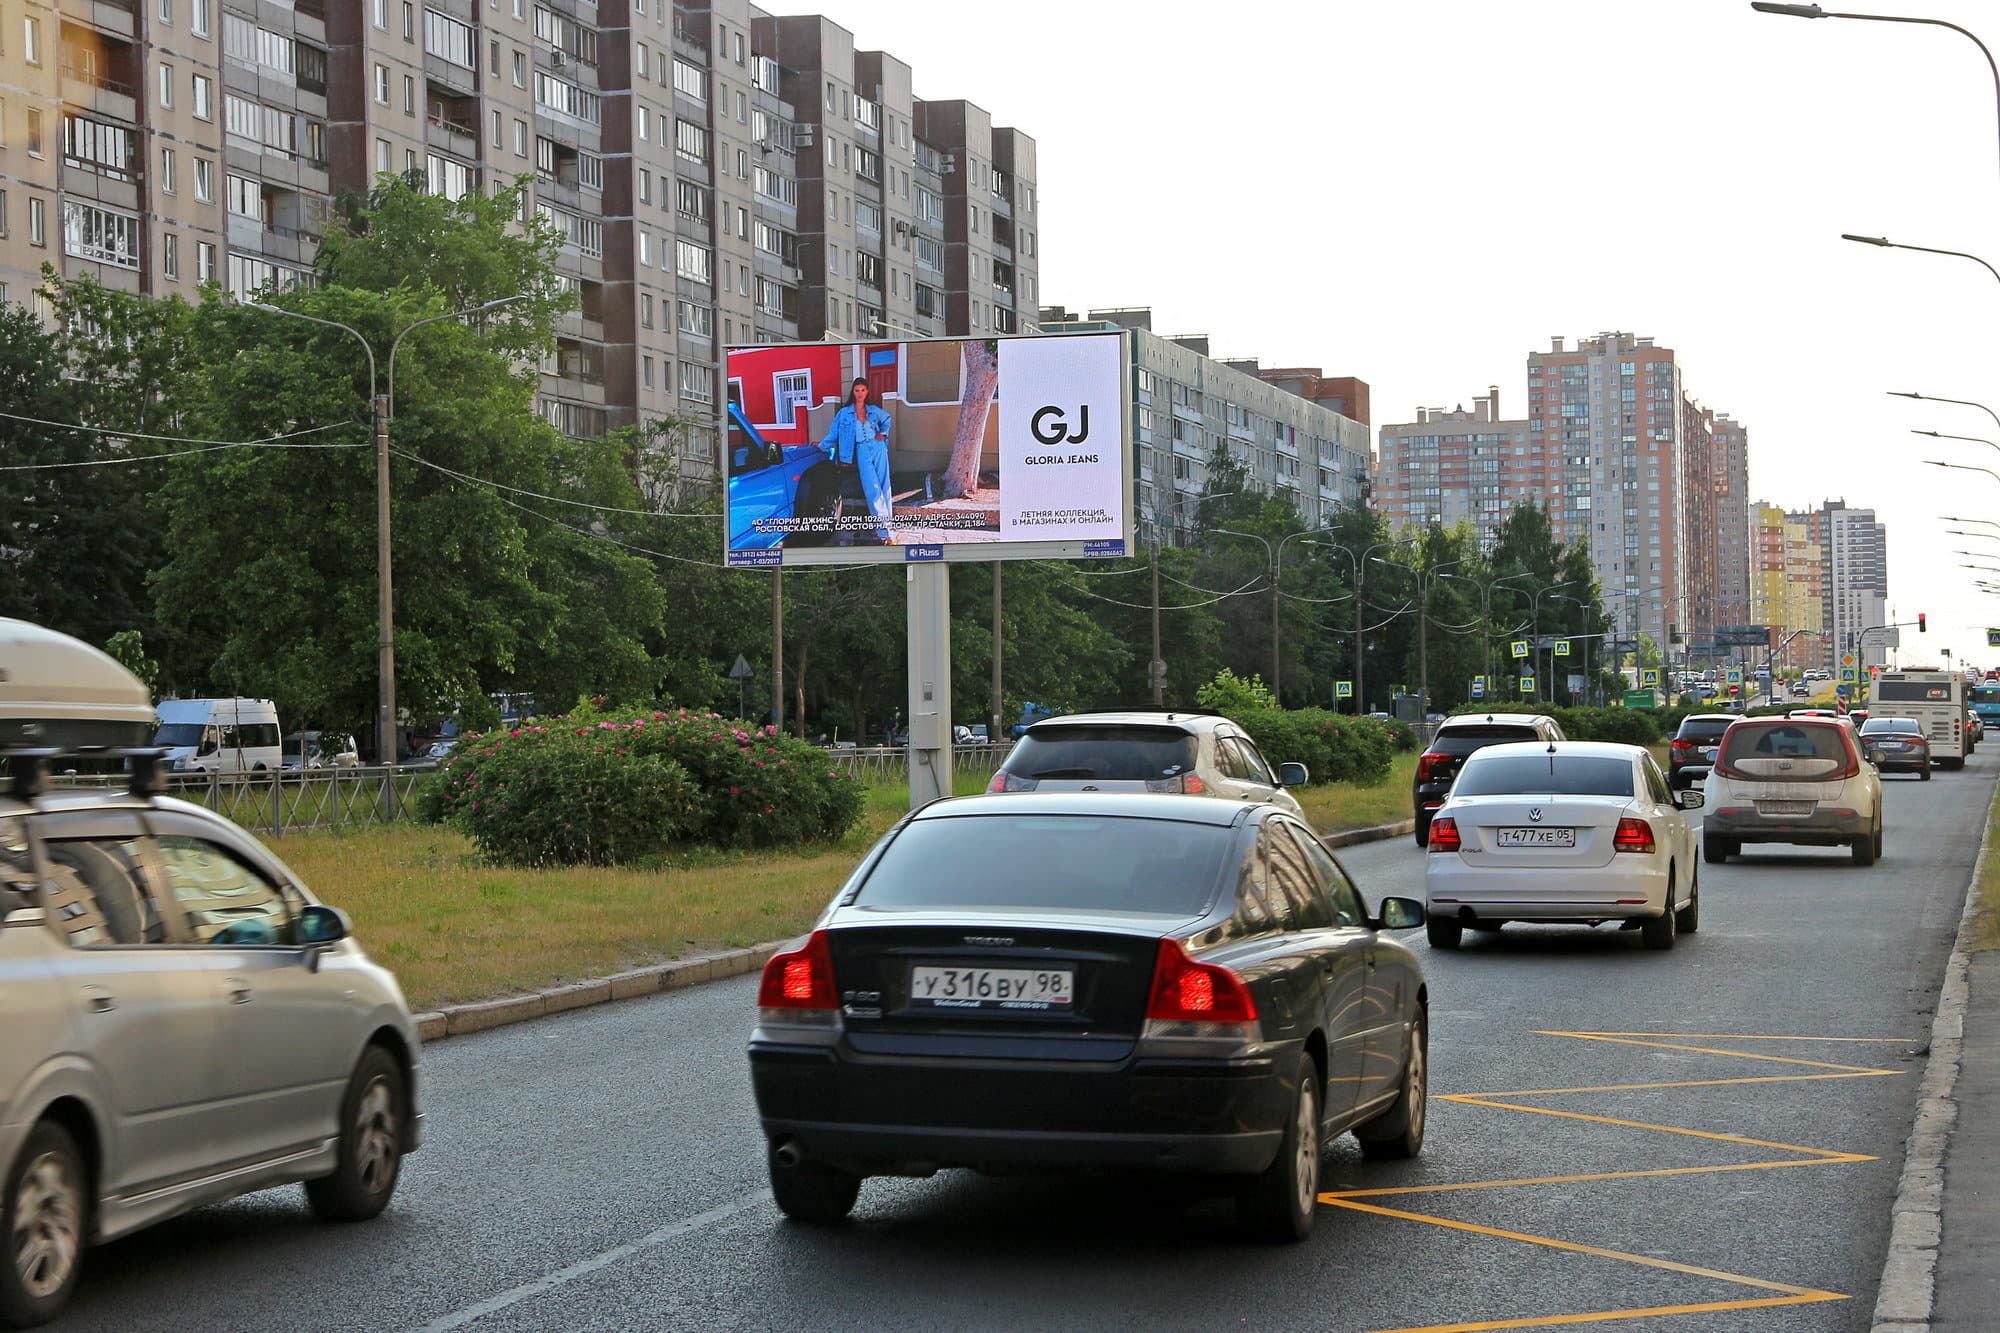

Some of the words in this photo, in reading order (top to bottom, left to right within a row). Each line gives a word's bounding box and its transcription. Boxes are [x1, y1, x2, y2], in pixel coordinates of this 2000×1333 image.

[1031, 405, 1088, 445] GJ
[1025, 456, 1064, 465] GLORIA
[1067, 454, 1099, 464] JEANS
[841, 515, 862, 524] ОГРН
[925, 513, 954, 521] АДРЕС:
[1020, 510, 1053, 518] ЛЕТНЯЯ
[1019, 517, 1068, 526] МАГАЗИНАХ
[1078, 515, 1114, 524] ОНЛАЙН
[755, 524, 810, 533] РОСТОВСКАЯ
[919, 548, 940, 557] Russ
[1503, 829, 1553, 842] Т477ХЕ
[1556, 829, 1570, 839] 05
[924, 970, 1028, 998] У316ВУ
[1036, 973, 1063, 993] 98
